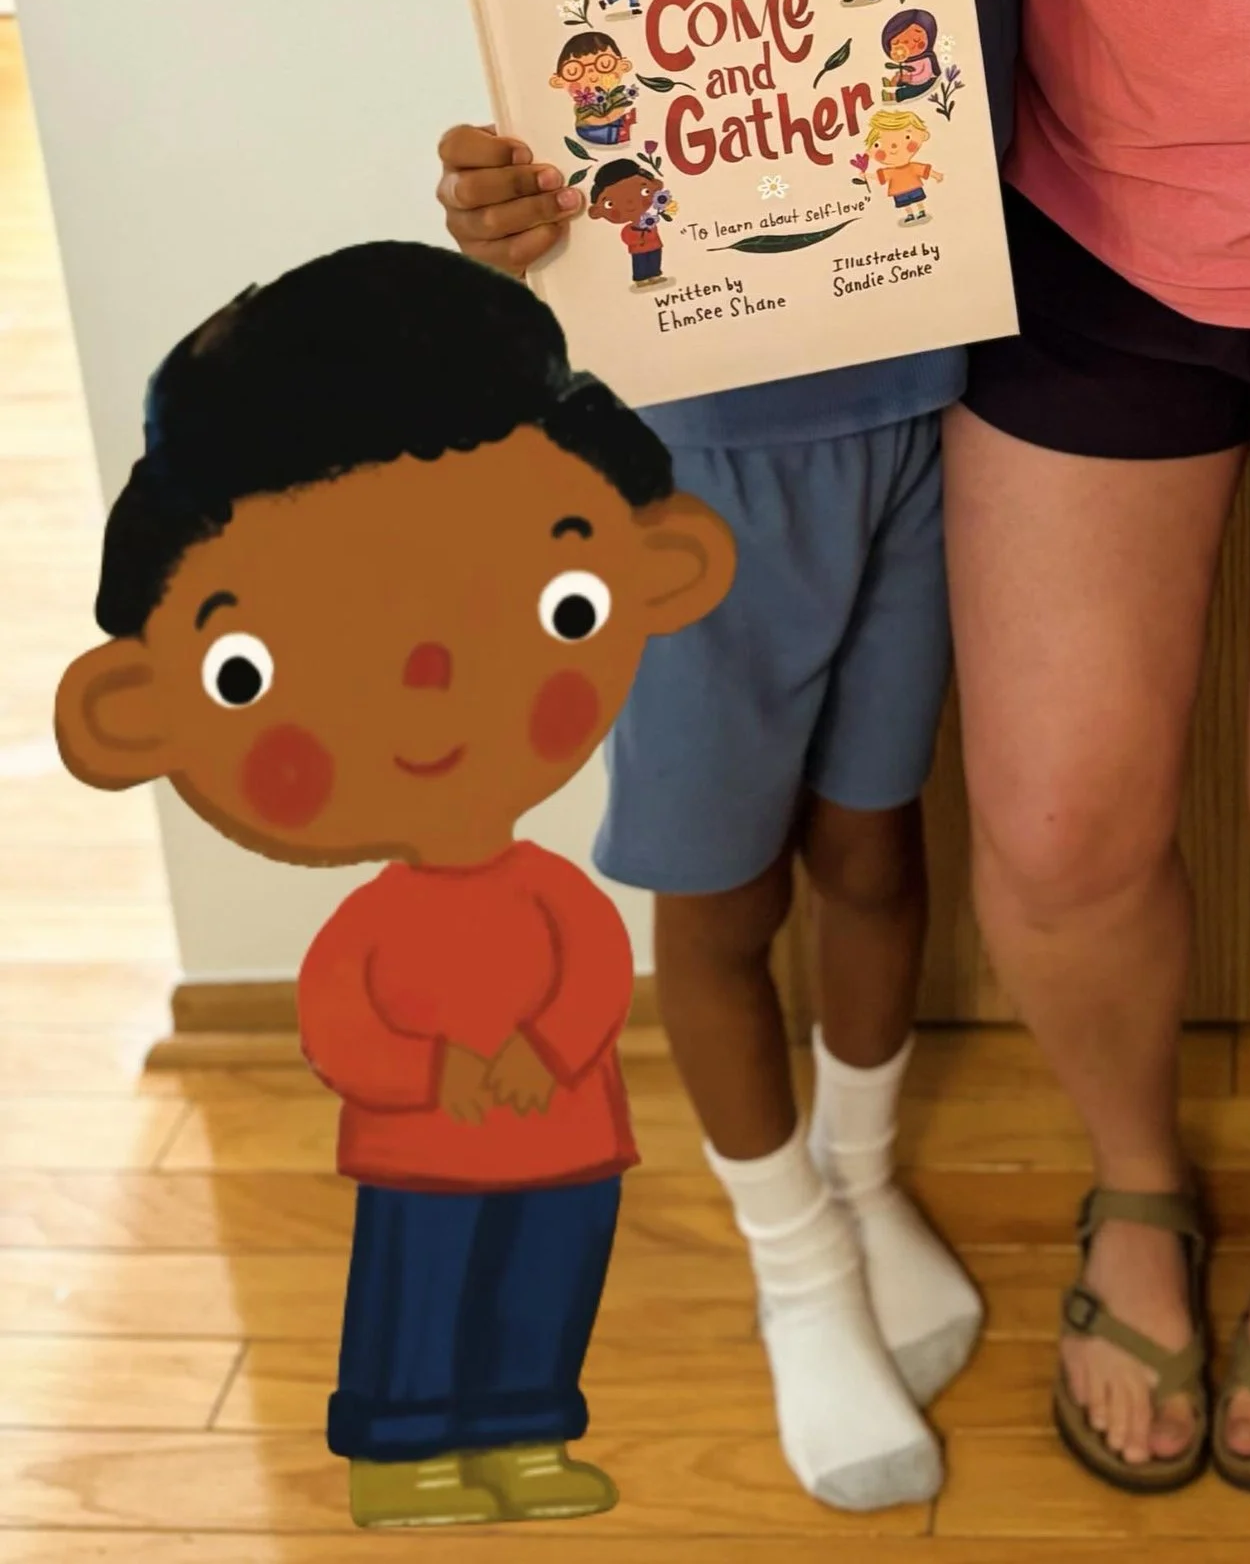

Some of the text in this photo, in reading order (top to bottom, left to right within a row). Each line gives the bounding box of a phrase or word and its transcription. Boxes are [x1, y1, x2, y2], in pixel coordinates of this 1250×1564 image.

[705, 40, 776, 99] and
[665, 82, 874, 175] Gather
[714, 221, 753, 238] learn
[759, 209, 800, 228] about
[832, 243, 941, 273] Illustrated by
[725, 276, 744, 294] by
[833, 262, 933, 298] Sandie Sonke
[658, 295, 787, 333] Ehmsee Shane
